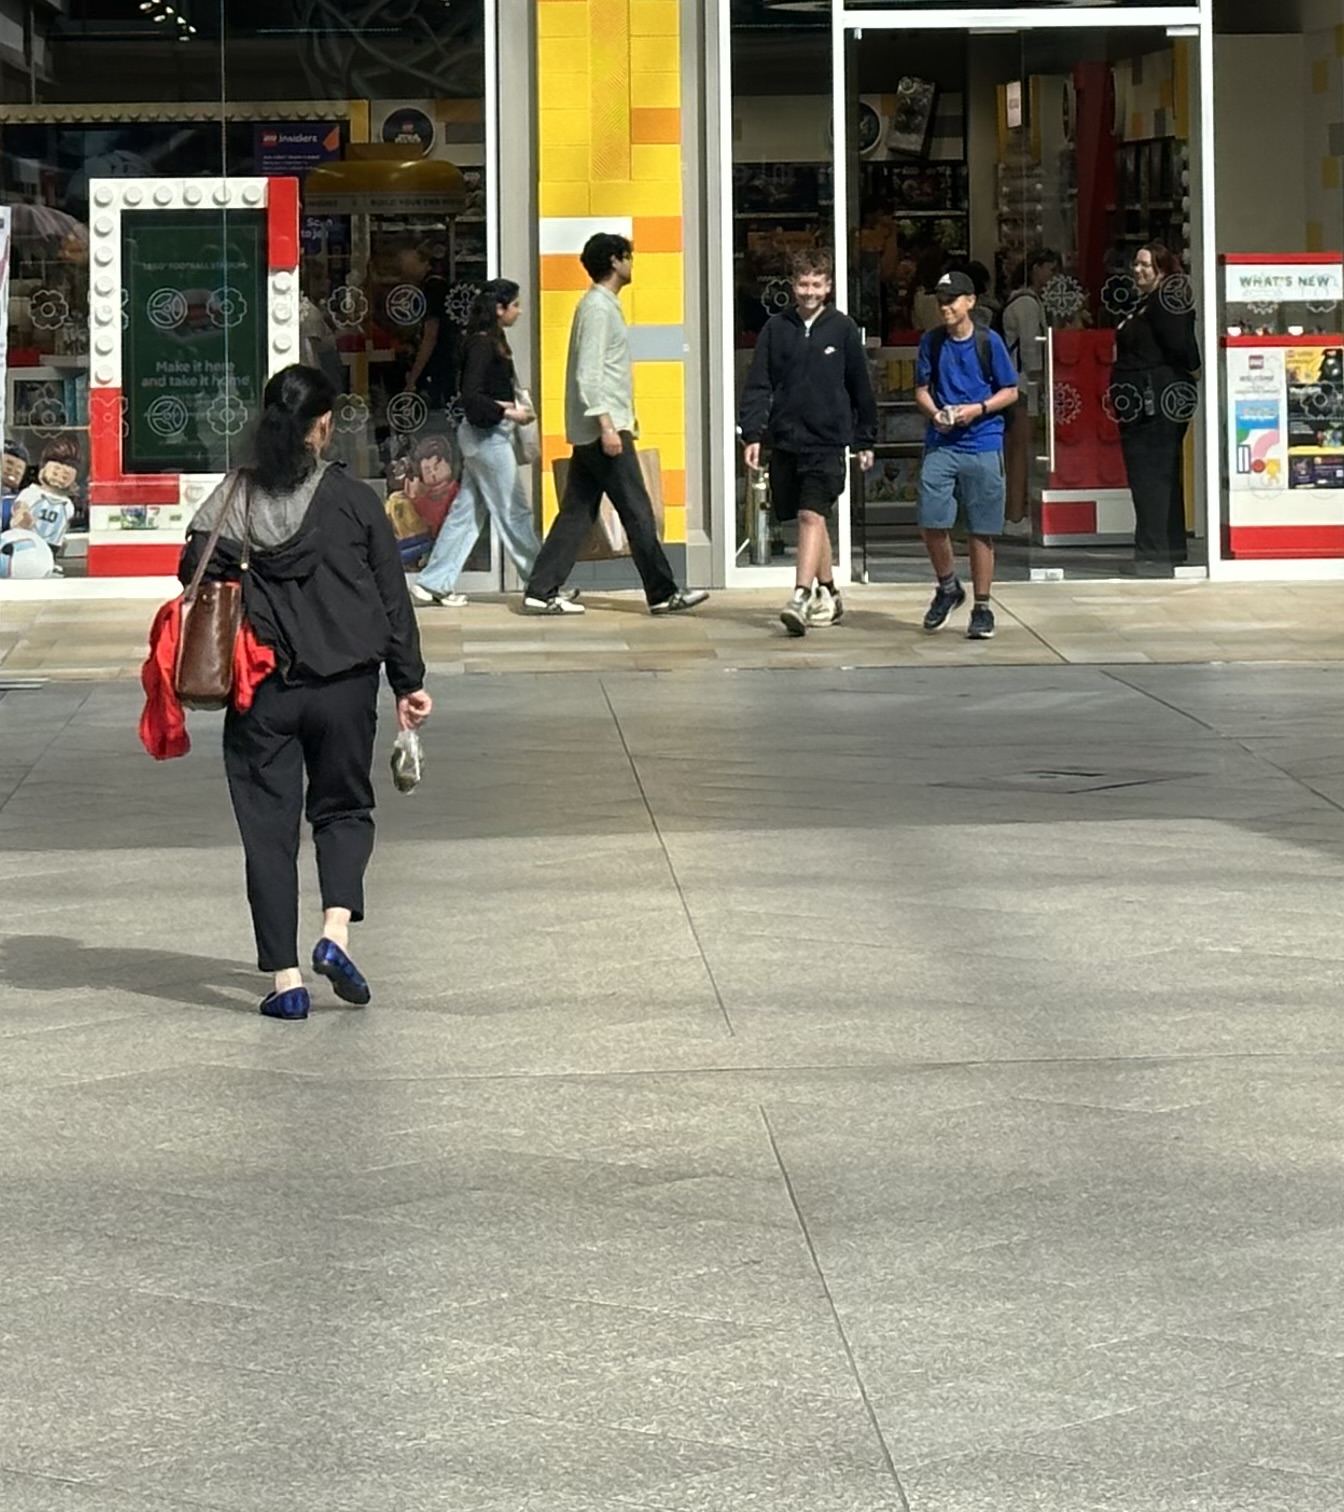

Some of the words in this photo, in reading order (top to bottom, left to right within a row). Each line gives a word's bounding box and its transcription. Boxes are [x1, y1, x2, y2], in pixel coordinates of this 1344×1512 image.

[1239, 275, 1293, 287] WHAT'S
[1298, 275, 1329, 287] NEW
[156, 360, 190, 373] Make
[193, 360, 203, 373] it
[142, 375, 166, 387] and
[169, 374, 197, 387] take
[39, 508, 58, 524] 10
